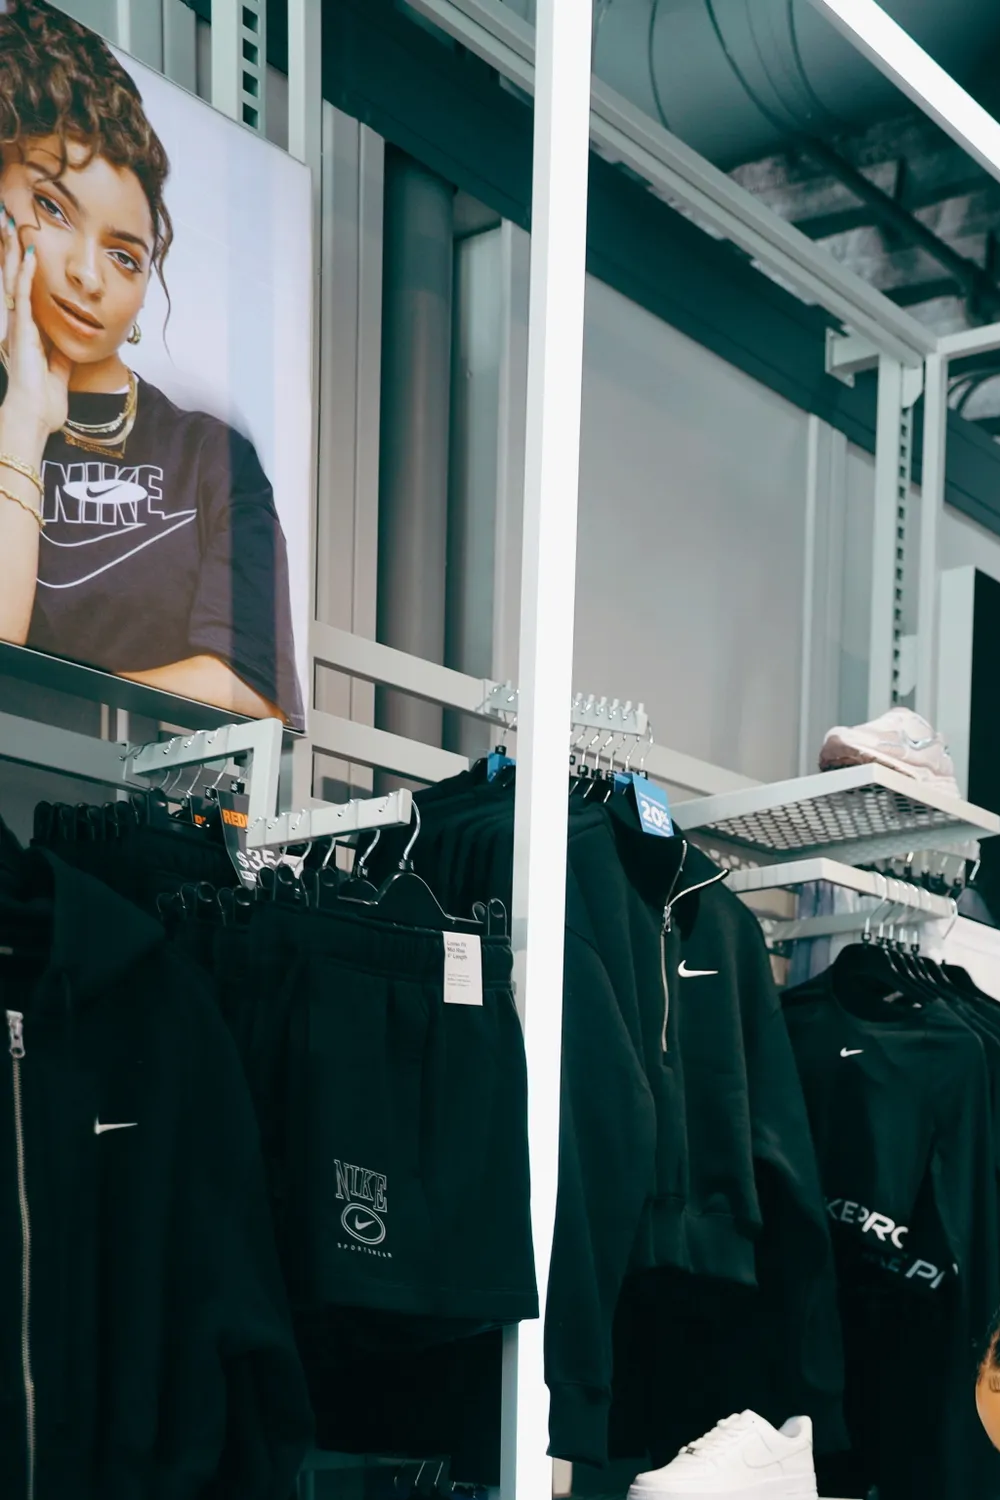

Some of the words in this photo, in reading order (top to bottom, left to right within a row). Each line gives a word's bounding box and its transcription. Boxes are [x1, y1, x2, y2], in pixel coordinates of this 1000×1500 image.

[41, 461, 164, 526] NIKE
[236, 849, 277, 870] $35
[333, 1158, 389, 1213] NIKE
[336, 1241, 394, 1259] SPORTSWEAR
